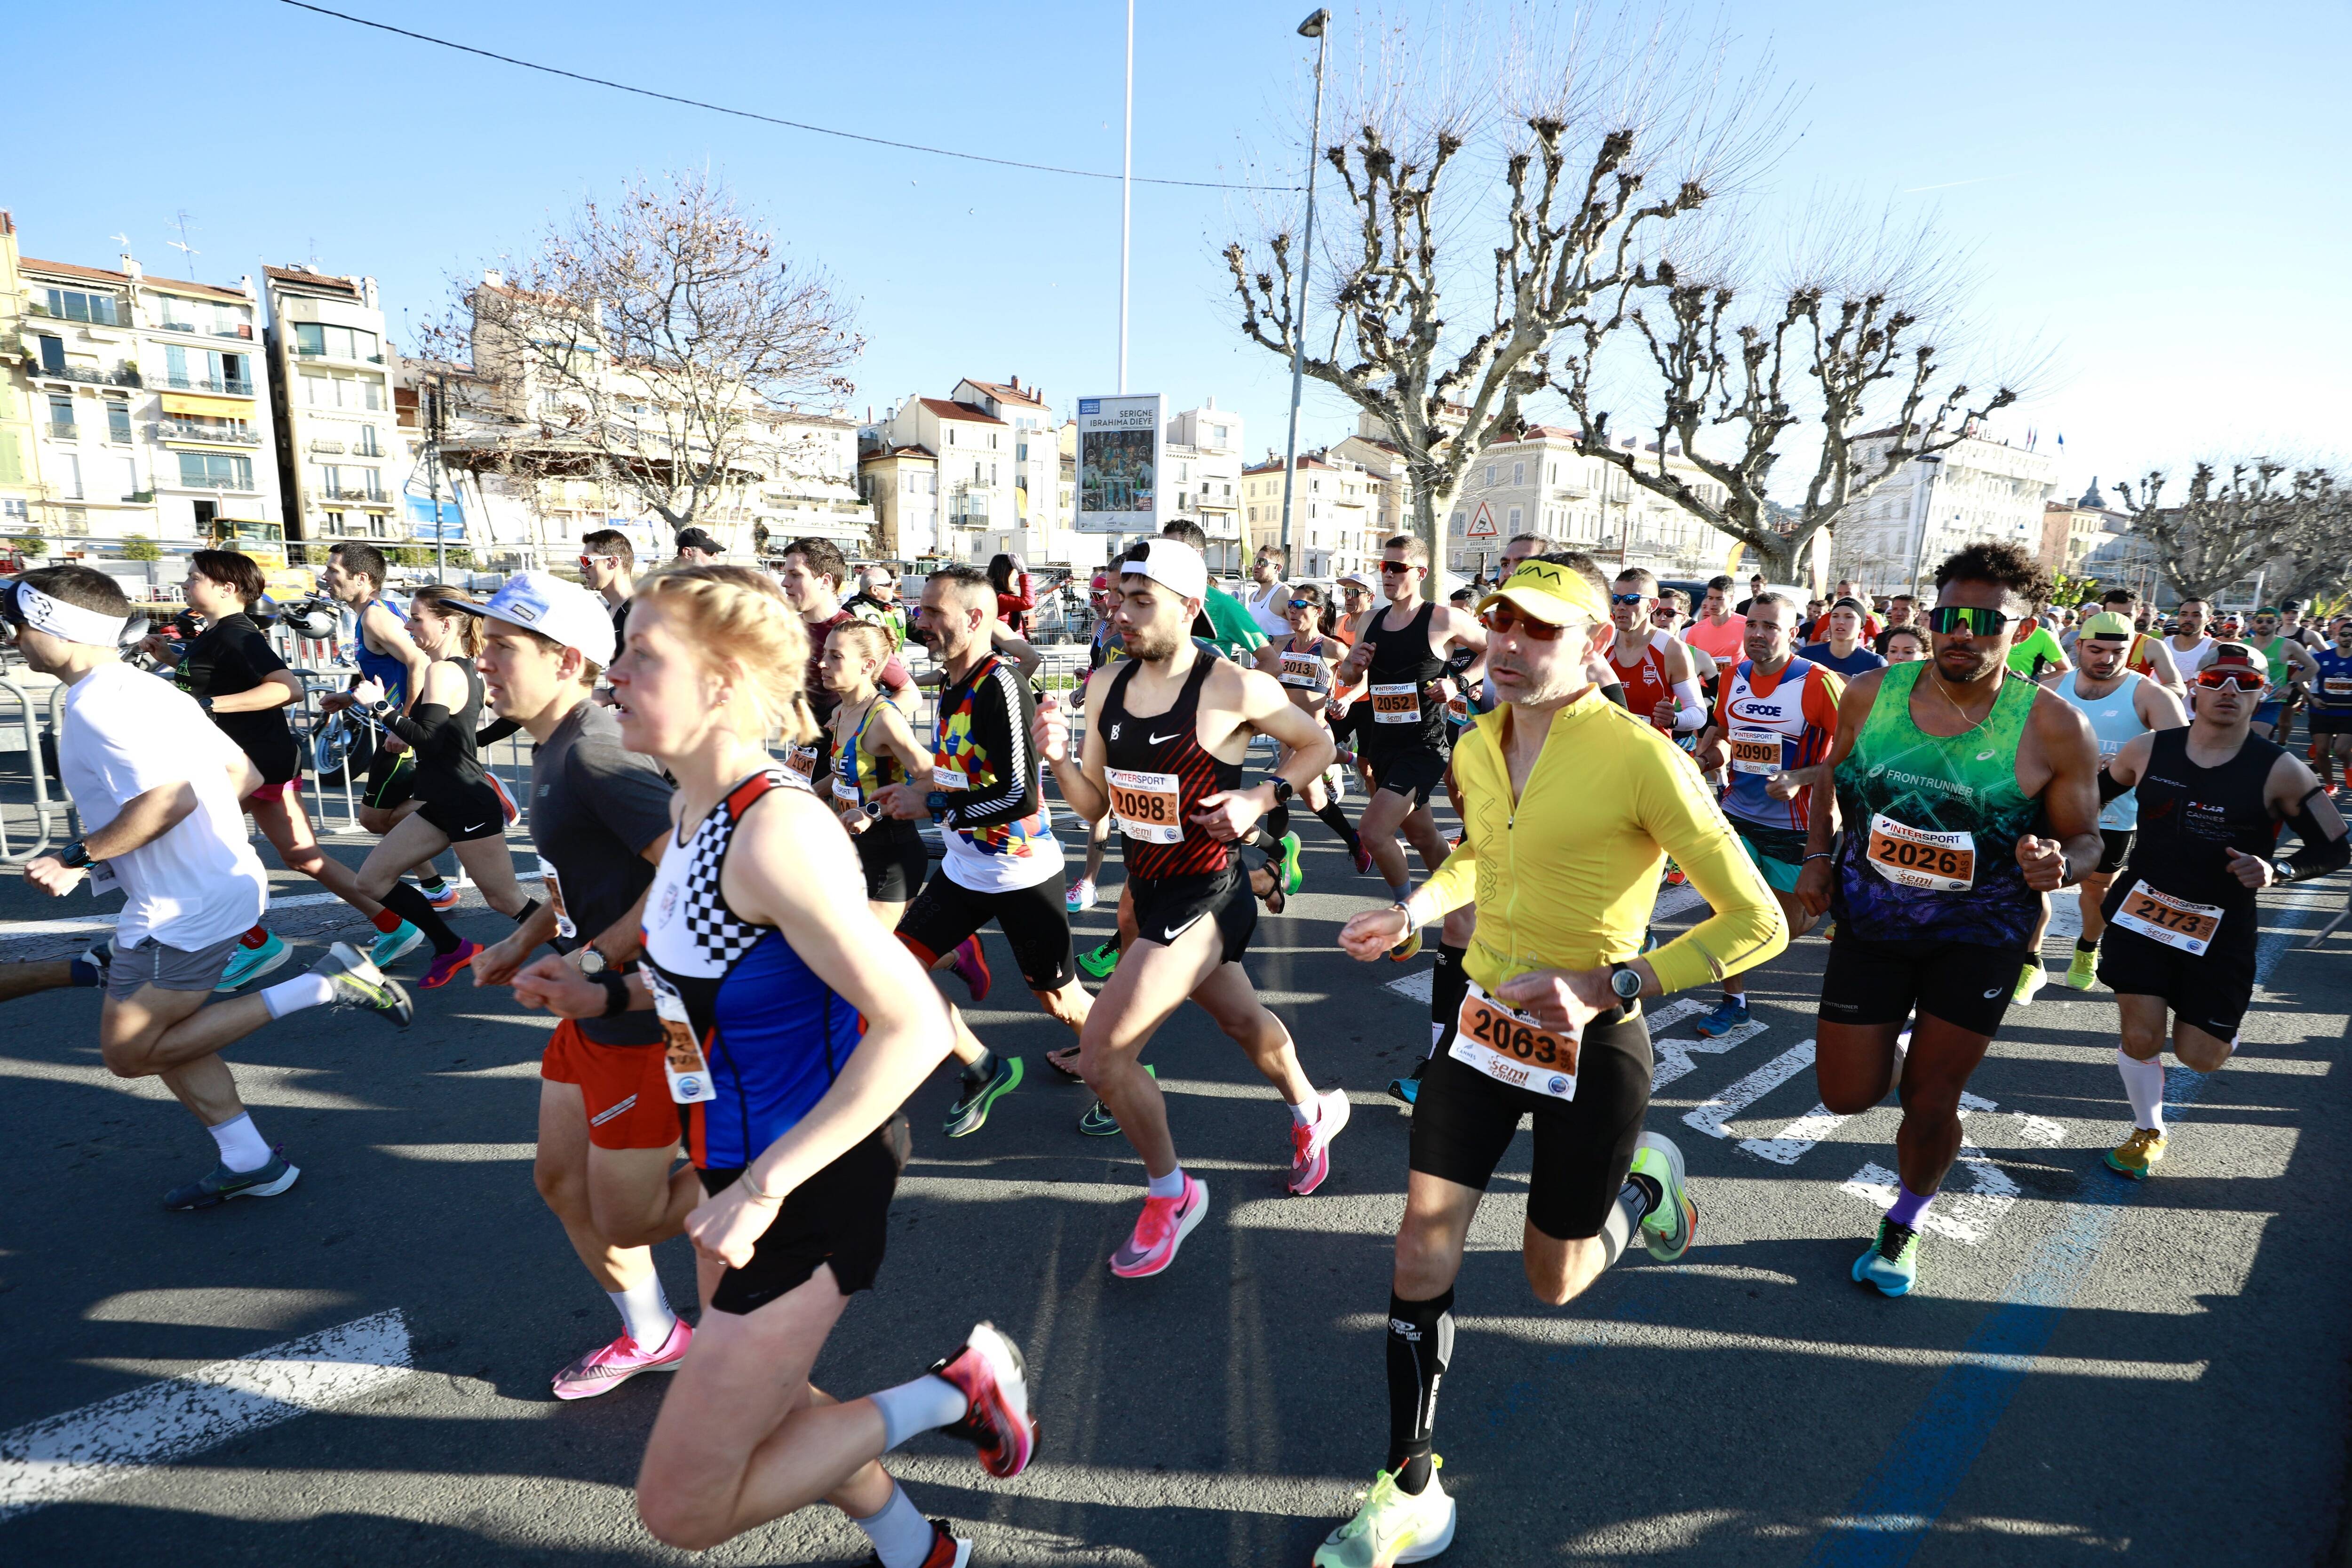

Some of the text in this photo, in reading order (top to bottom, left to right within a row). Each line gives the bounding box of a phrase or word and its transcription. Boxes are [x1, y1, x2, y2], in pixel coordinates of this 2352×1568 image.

[1283, 661, 1311, 675] 3013
[1377, 696, 1410, 710] 2052
[1746, 704, 1781, 717] SPODE
[1736, 743, 1772, 761] 2090
[1117, 772, 1165, 785] INTERSPORT
[1886, 769, 1973, 797] FRONTRUNNER
[1117, 791, 1165, 820] 2098
[1941, 792, 1970, 805] FRANCE
[2186, 811, 2225, 822] CANNES
[1131, 826, 1152, 836] semi
[1890, 824, 1960, 844] INTERSPORT
[1917, 839, 1950, 848] MANDELIEU
[1880, 840, 1957, 874] 2026
[1959, 860, 1969, 879] SAS
[1900, 873, 1934, 885] semi
[2136, 900, 2201, 932] 2173
[2146, 927, 2176, 940] semi
[1488, 997, 1508, 1015] CANNES
[1822, 999, 1858, 1010] RONTRUNNER
[1473, 1009, 1556, 1063] 2063
[1456, 1047, 1476, 1060] CANNES
[1492, 1060, 1530, 1081] semi
[1492, 1070, 1526, 1087] cannes
[1395, 1329, 1422, 1338] SPORT
[1425, 1374, 1441, 1430] BOOSTER
